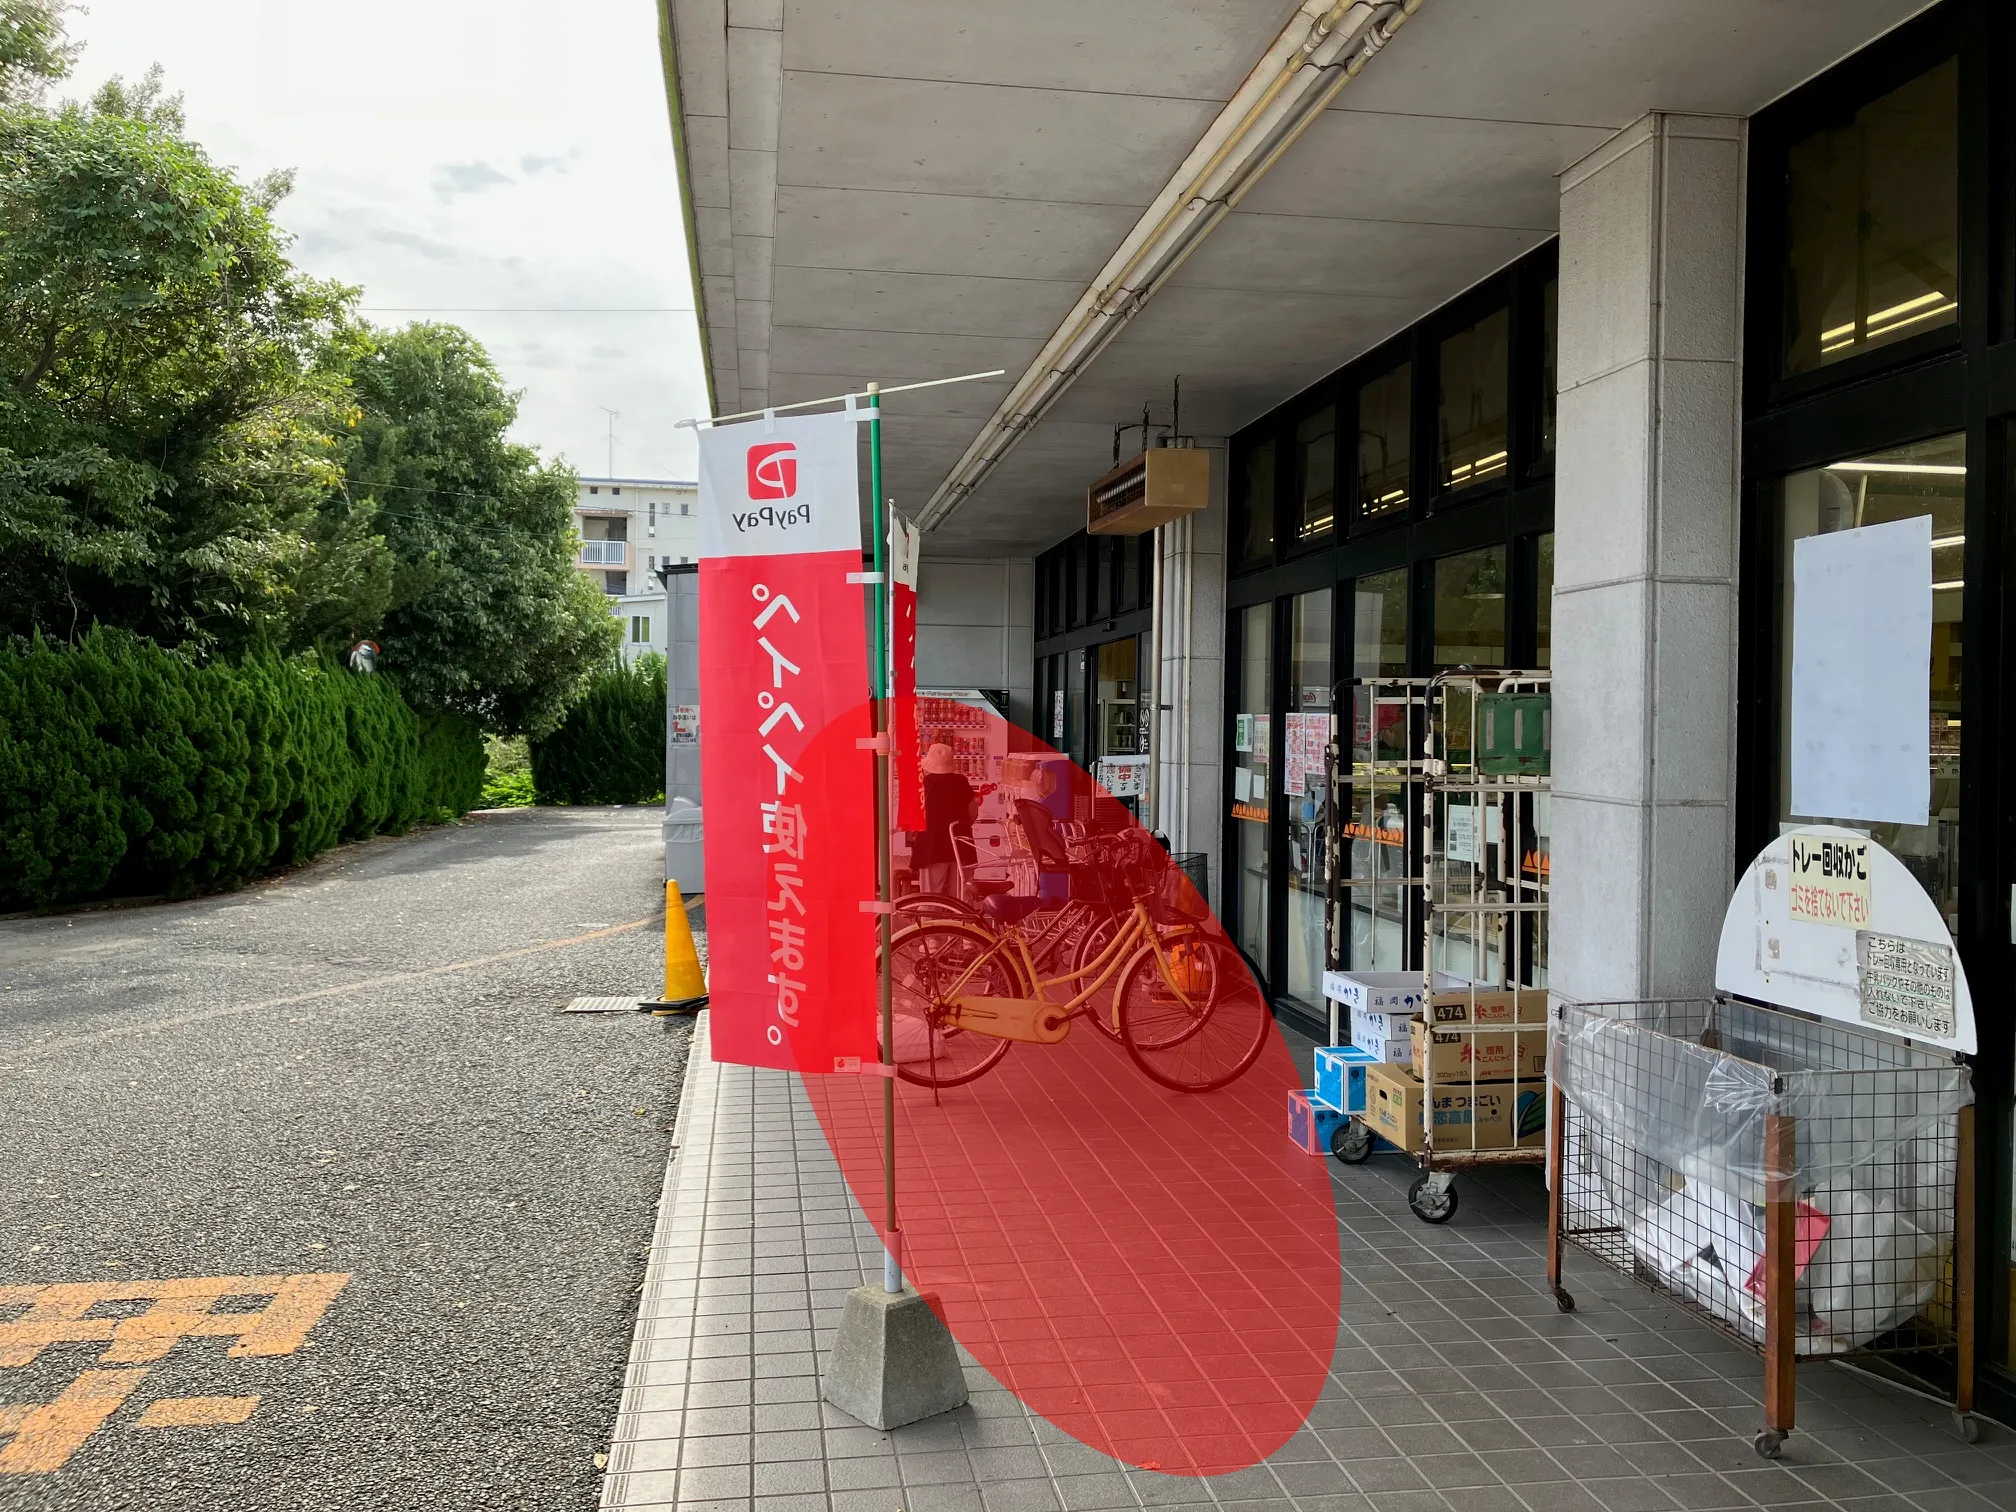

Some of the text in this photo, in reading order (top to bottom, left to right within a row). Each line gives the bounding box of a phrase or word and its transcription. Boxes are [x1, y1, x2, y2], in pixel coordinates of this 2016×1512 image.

[1792, 838, 1868, 880] トレー回収かご
[1791, 883, 1869, 923] ゴミを捨てないで下さい
[1868, 936, 1905, 954] こちらは
[1437, 1006, 1464, 1020] 474
[1868, 1001, 1950, 1034] ご協力をお願いします
[1482, 1055, 1511, 1063] こんにゃく
[1455, 1094, 1502, 1108] つまごい
